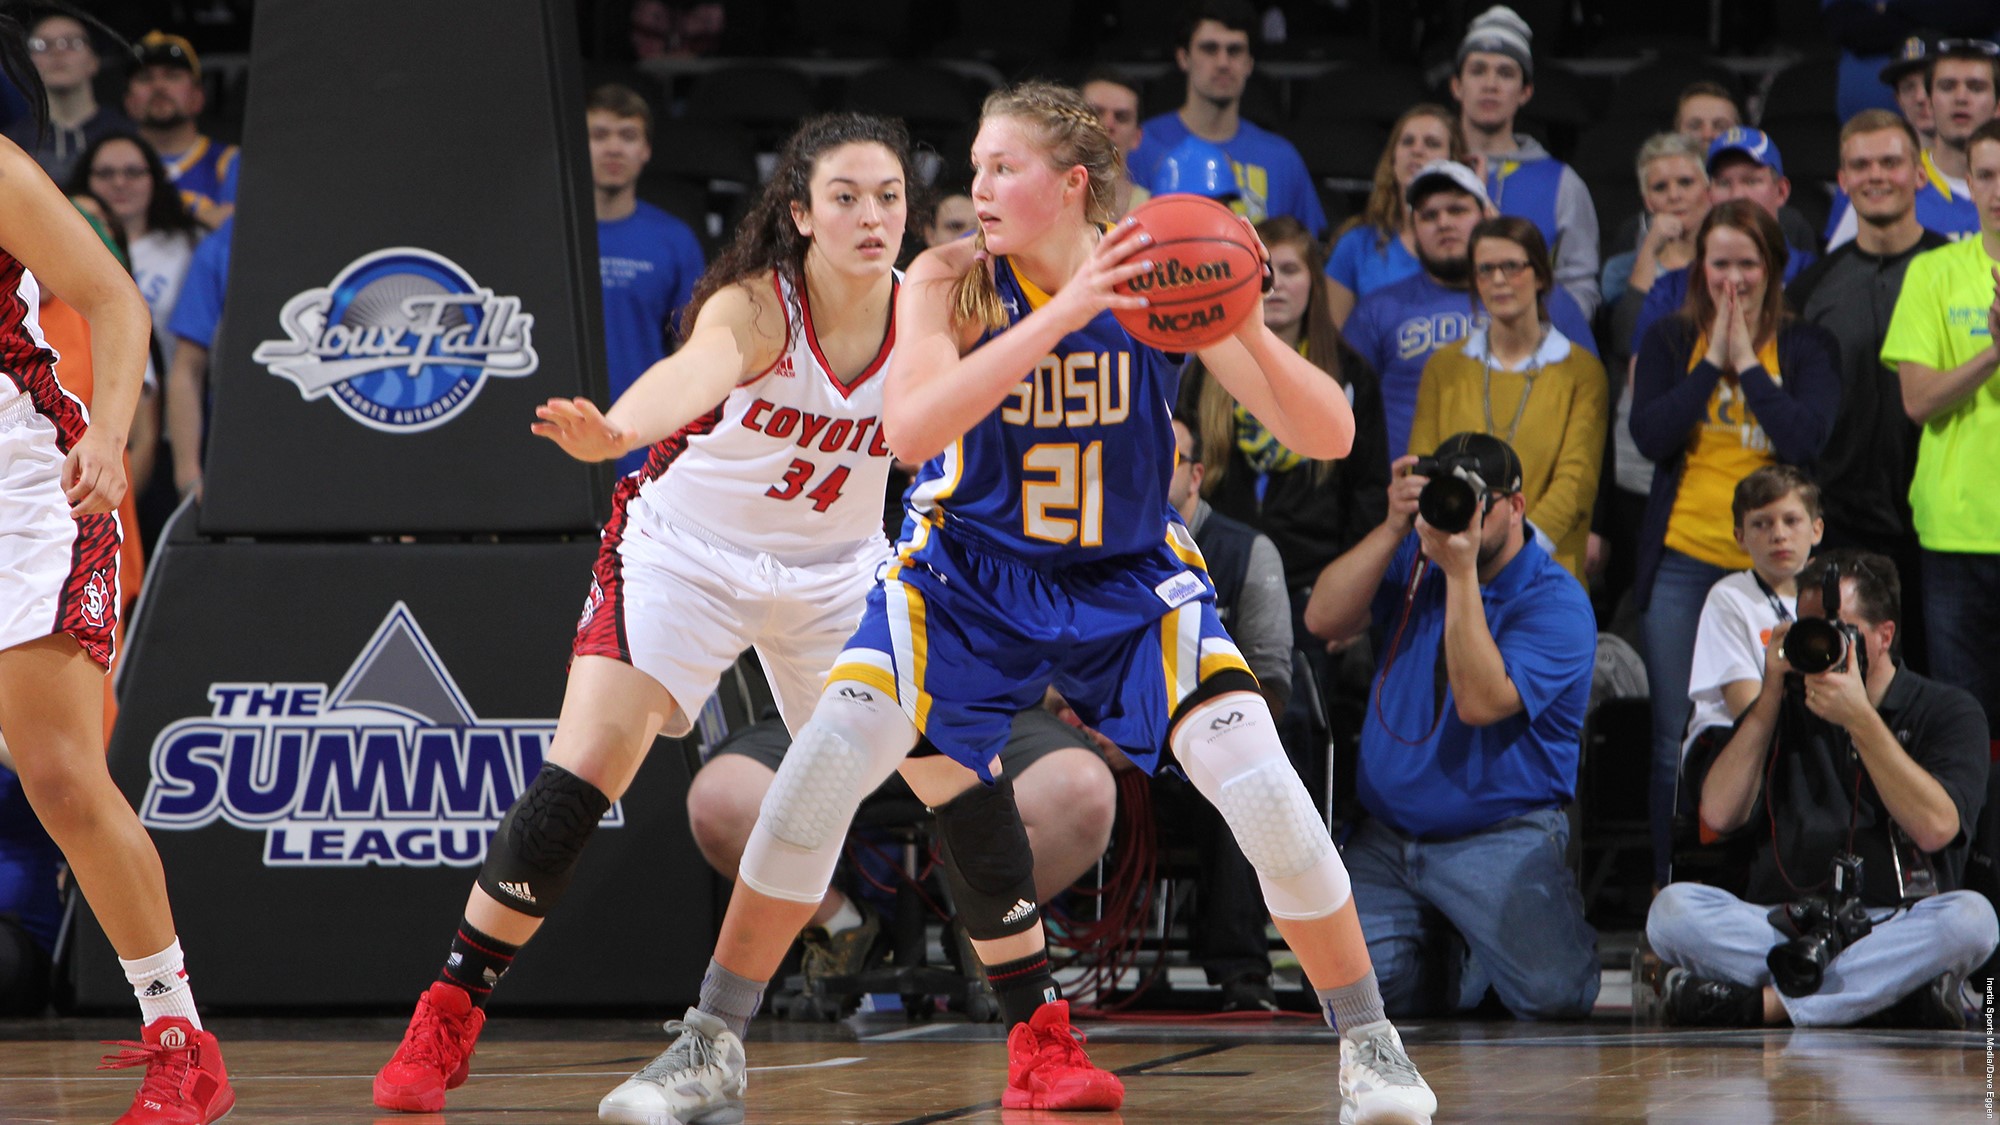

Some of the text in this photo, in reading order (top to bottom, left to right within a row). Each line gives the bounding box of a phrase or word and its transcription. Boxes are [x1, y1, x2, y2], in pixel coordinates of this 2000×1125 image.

[1127, 258, 1233, 292] Wilson
[254, 288, 534, 377] Sioux Falls
[1147, 303, 1226, 332] NCAA
[337, 378, 471, 424] SPORTS AUTHORITY
[741, 398, 894, 457] COYOTE
[764, 457, 852, 513] 34
[1022, 439, 1104, 547] 21
[209, 686, 324, 717] THE
[146, 730, 553, 818] SUMMI
[267, 828, 497, 861] LEAGU
